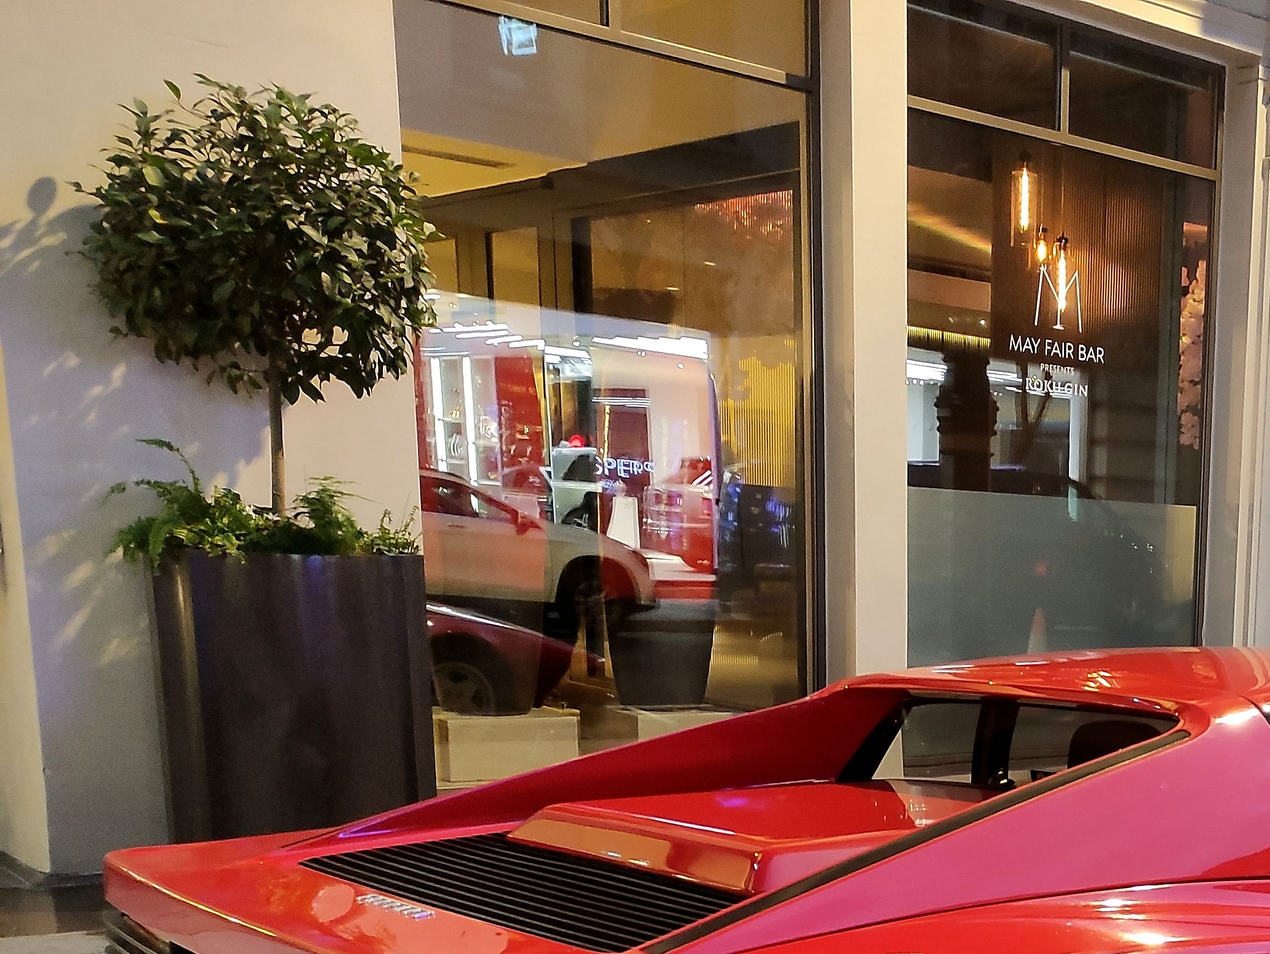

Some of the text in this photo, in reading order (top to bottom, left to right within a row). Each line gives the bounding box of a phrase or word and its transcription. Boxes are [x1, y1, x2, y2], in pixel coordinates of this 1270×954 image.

[1009, 334, 1105, 364] MAY FAIR BAR
[1040, 363, 1075, 376] PRESENTS
[1064, 382, 1088, 397] GIN
